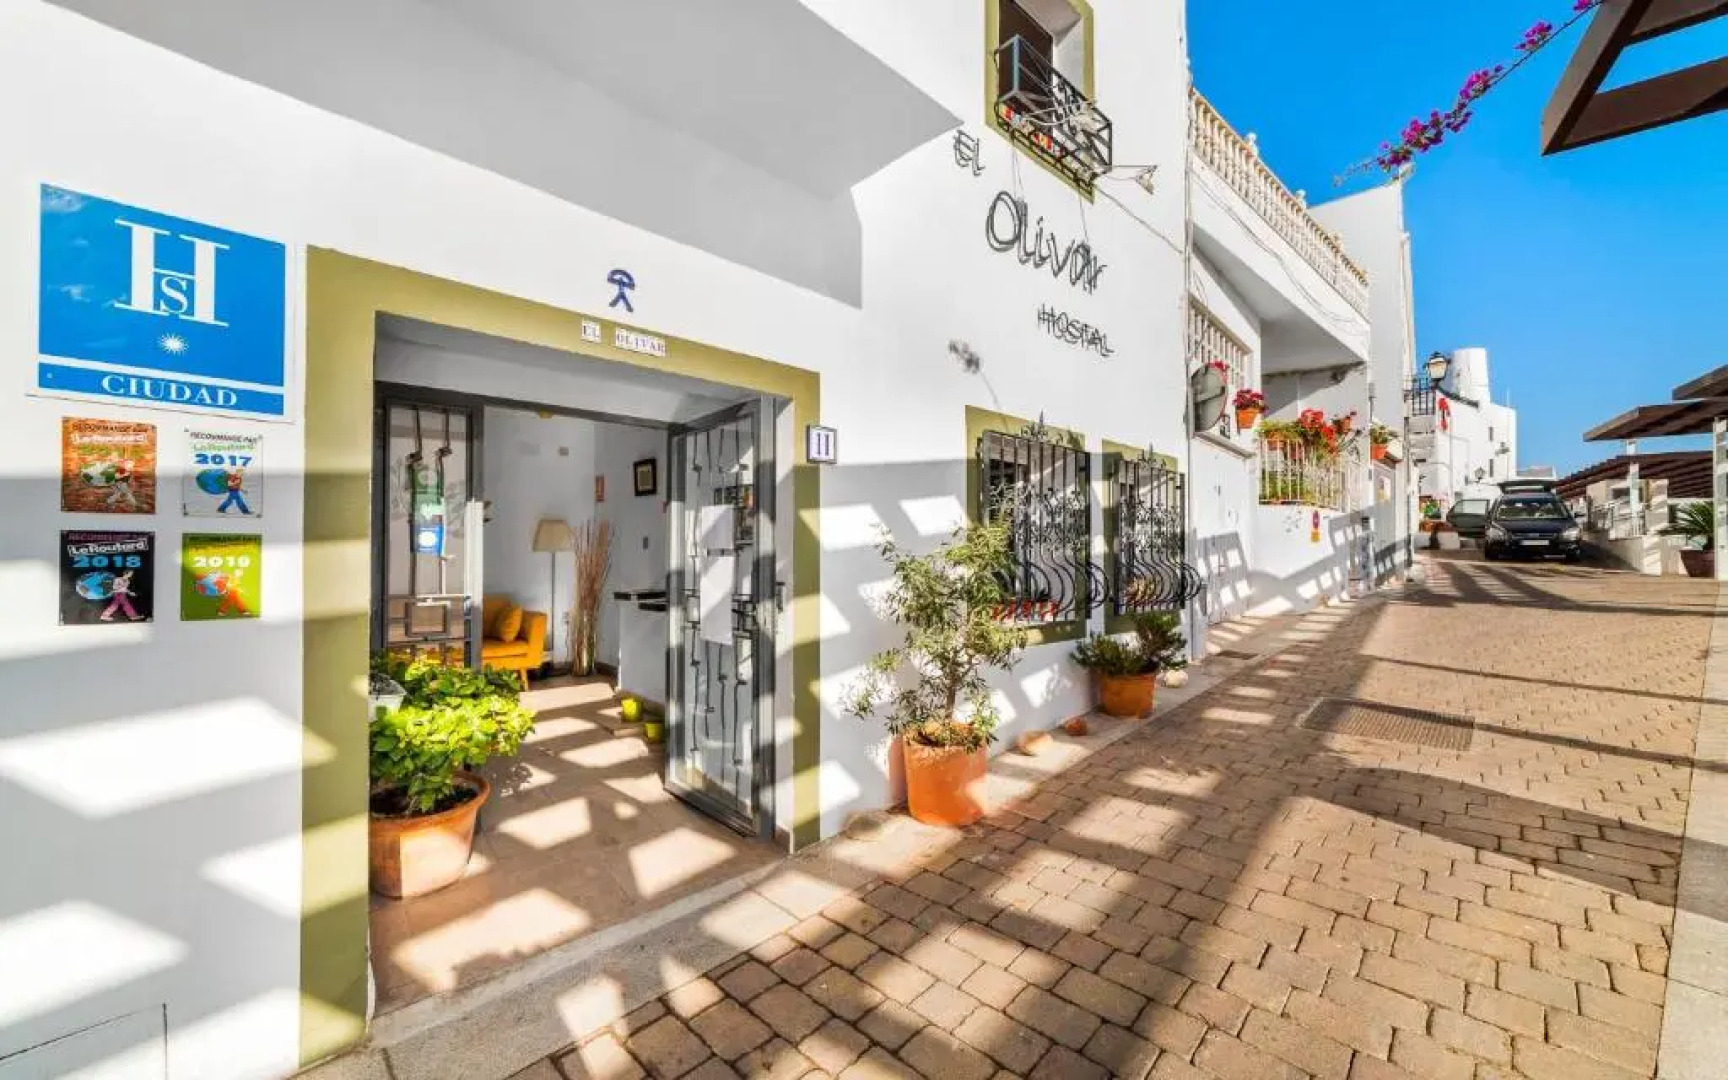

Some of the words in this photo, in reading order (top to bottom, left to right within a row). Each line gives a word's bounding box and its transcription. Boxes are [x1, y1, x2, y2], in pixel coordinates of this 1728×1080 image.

[1037, 303, 1115, 357] HOSTAL
[102, 375, 237, 406] CIUDAD
[195, 453, 252, 467] 2017
[72, 554, 141, 568] 2018
